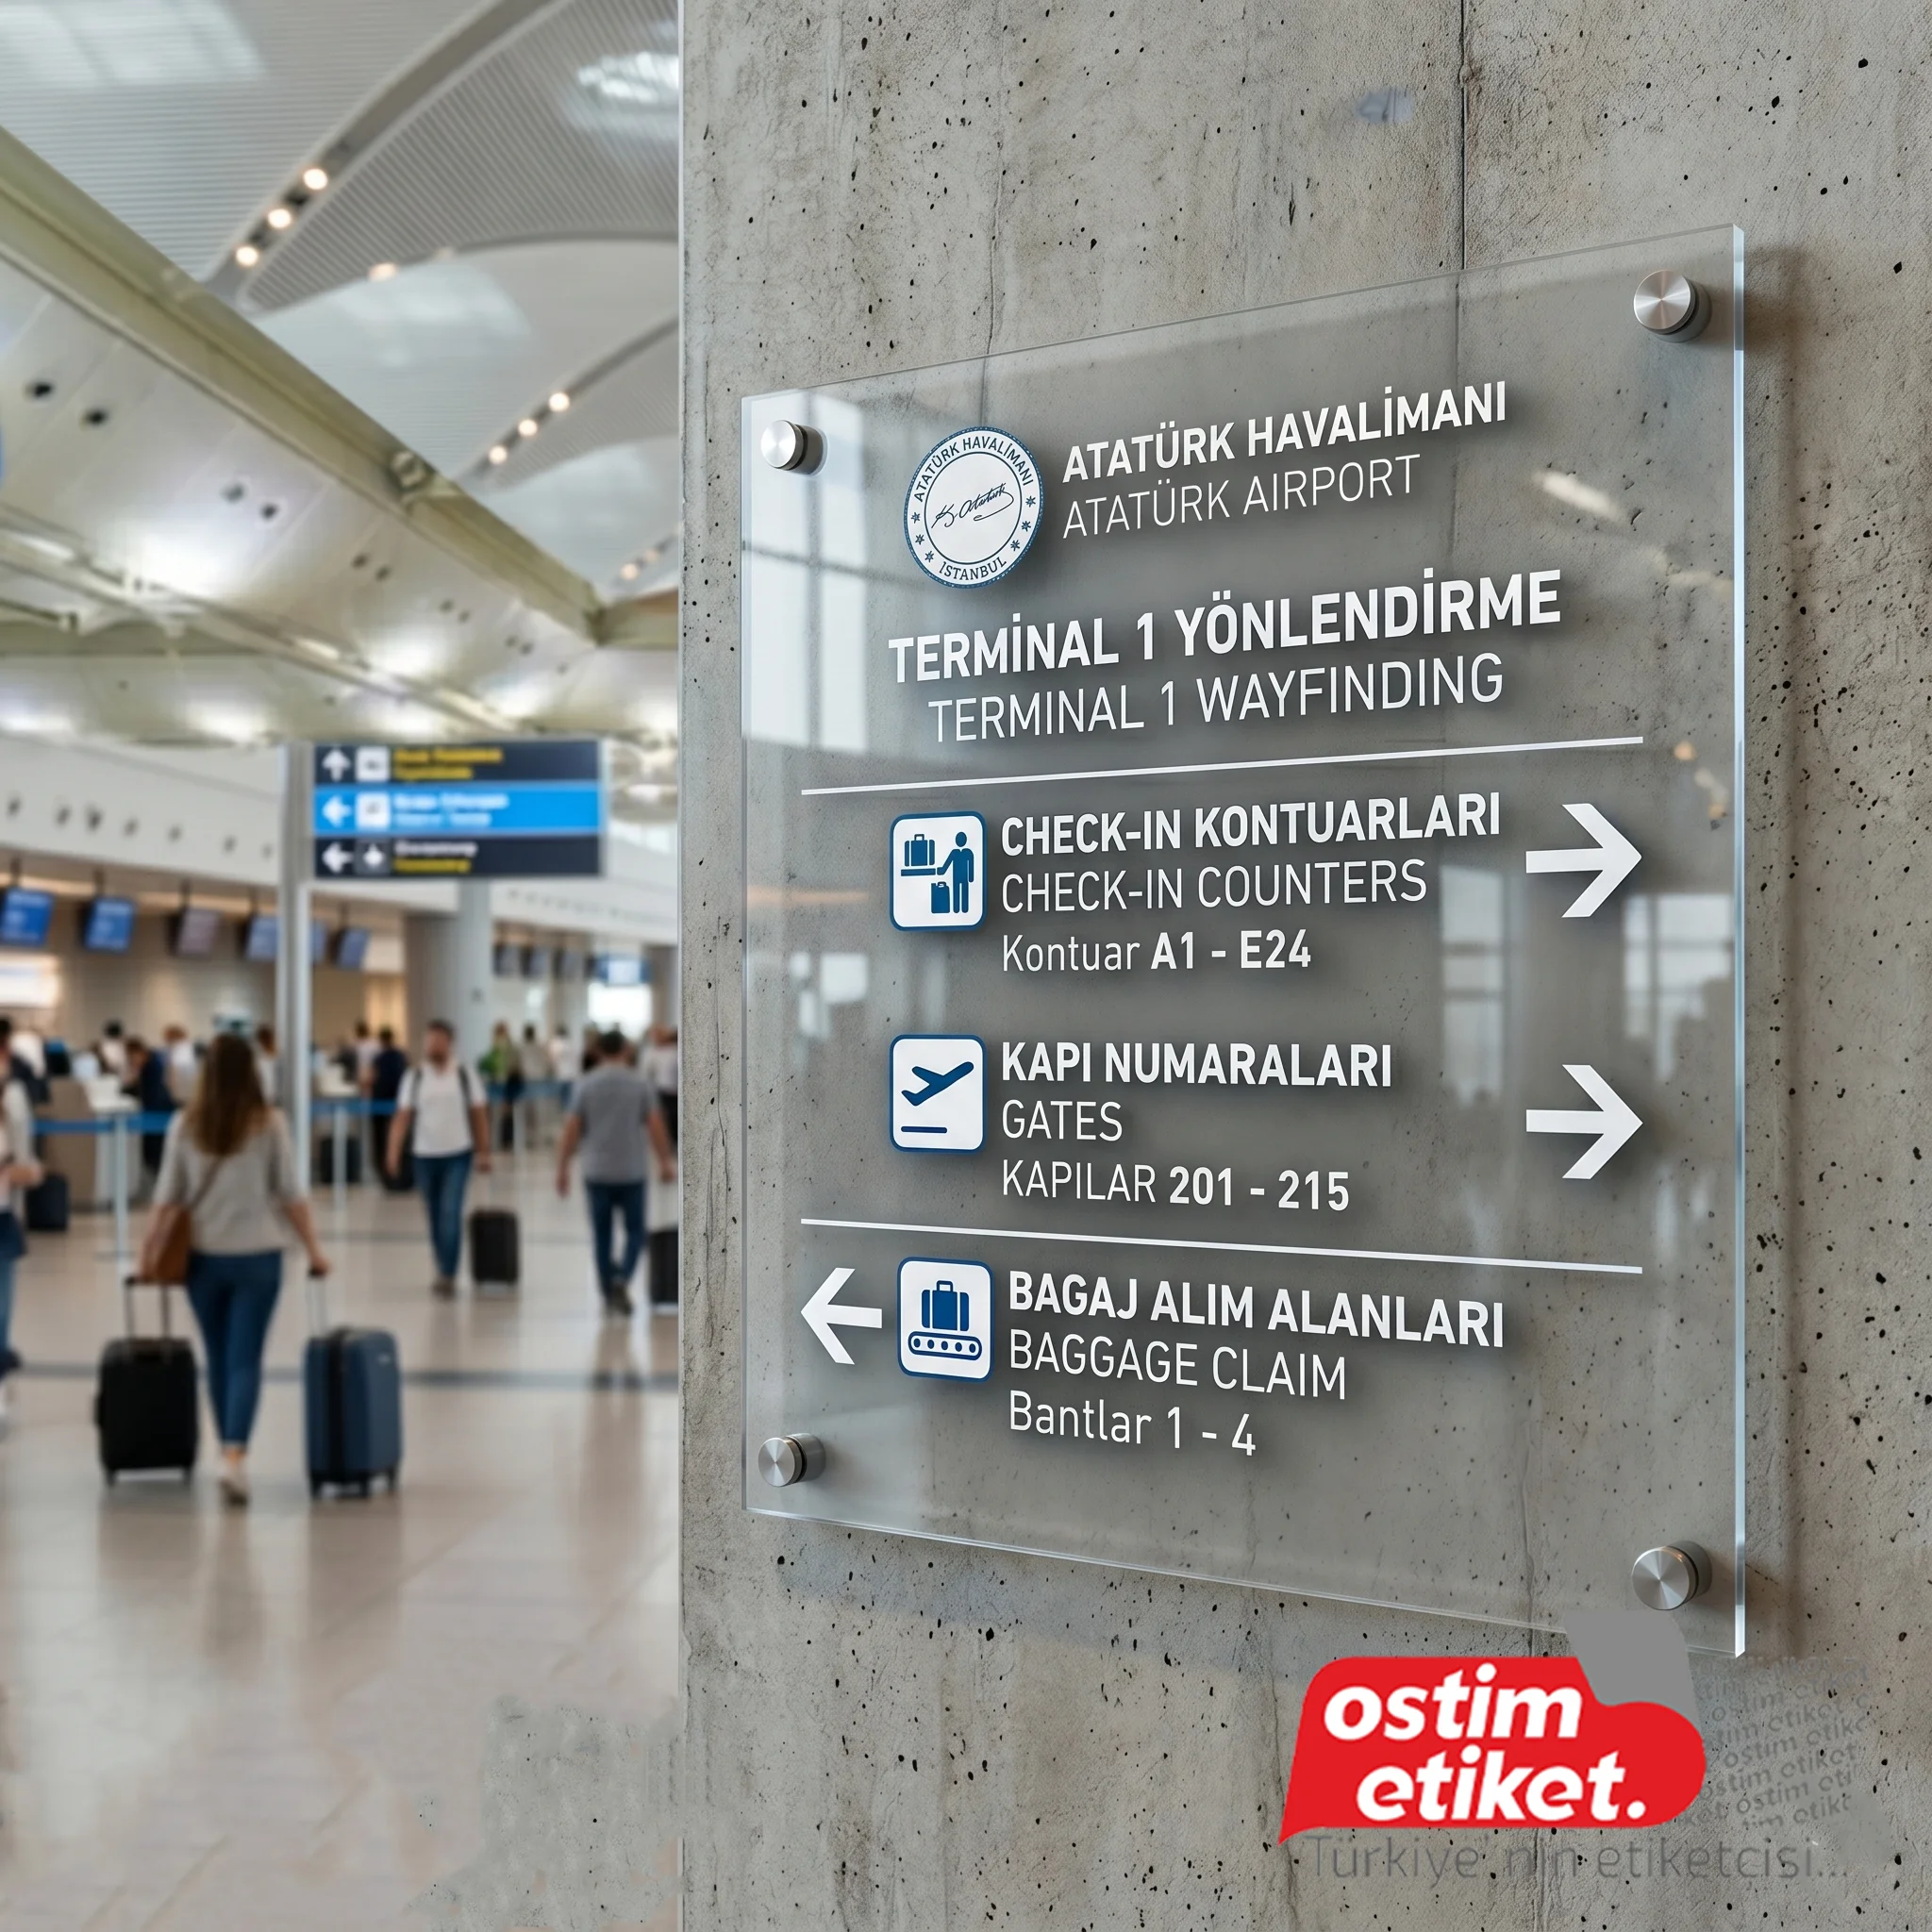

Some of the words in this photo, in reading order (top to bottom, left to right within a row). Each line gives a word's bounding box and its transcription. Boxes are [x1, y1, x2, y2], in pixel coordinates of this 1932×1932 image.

[1062, 420, 1236, 483] ATATÜRK
[1247, 380, 1506, 457] HAVALİMANI
[913, 441, 960, 503] ATATÜRK
[962, 435, 1034, 487] HAVALİMANI
[1062, 479, 1230, 539] ATATÜRK
[1242, 453, 1421, 515] AIRPORT
[888, 612, 1120, 684] TERMİNAL
[1137, 612, 1155, 660] 1
[1174, 566, 1562, 658] YÖNLENDİRME
[927, 685, 1145, 743] TERMINAL
[1160, 681, 1175, 726] 1
[1195, 652, 1504, 723] WAYFINDING
[1001, 808, 1182, 857] CHECK-IN
[1195, 791, 1501, 848] KONTUARLARI
[1001, 868, 1183, 913] CHECK-IN
[1198, 858, 1428, 909] COUNTERS
[1003, 934, 1141, 972] Kontuar
[1150, 931, 1195, 970] A1
[1241, 929, 1312, 970] E24
[1002, 1041, 1091, 1083] KAPI
[1105, 1042, 1391, 1088] NUMARALARI
[1002, 1099, 1123, 1141] GATES
[1003, 1158, 1157, 1203] KAPILAR
[1169, 1165, 1232, 1206] 201
[1250, 1187, 1265, 1196] -
[1278, 1169, 1350, 1211] 215
[1009, 1270, 1138, 1320] BAGAJ
[1150, 1280, 1254, 1328] ALIM
[1268, 1288, 1504, 1348] ALANLARI
[1009, 1328, 1199, 1387] BAGGAGE
[1212, 1345, 1345, 1400] CLAIM
[1009, 1390, 1152, 1445] Bantlar
[1167, 1407, 1181, 1449] 1
[1202, 1431, 1218, 1440] -
[1231, 1413, 1256, 1457] 4
